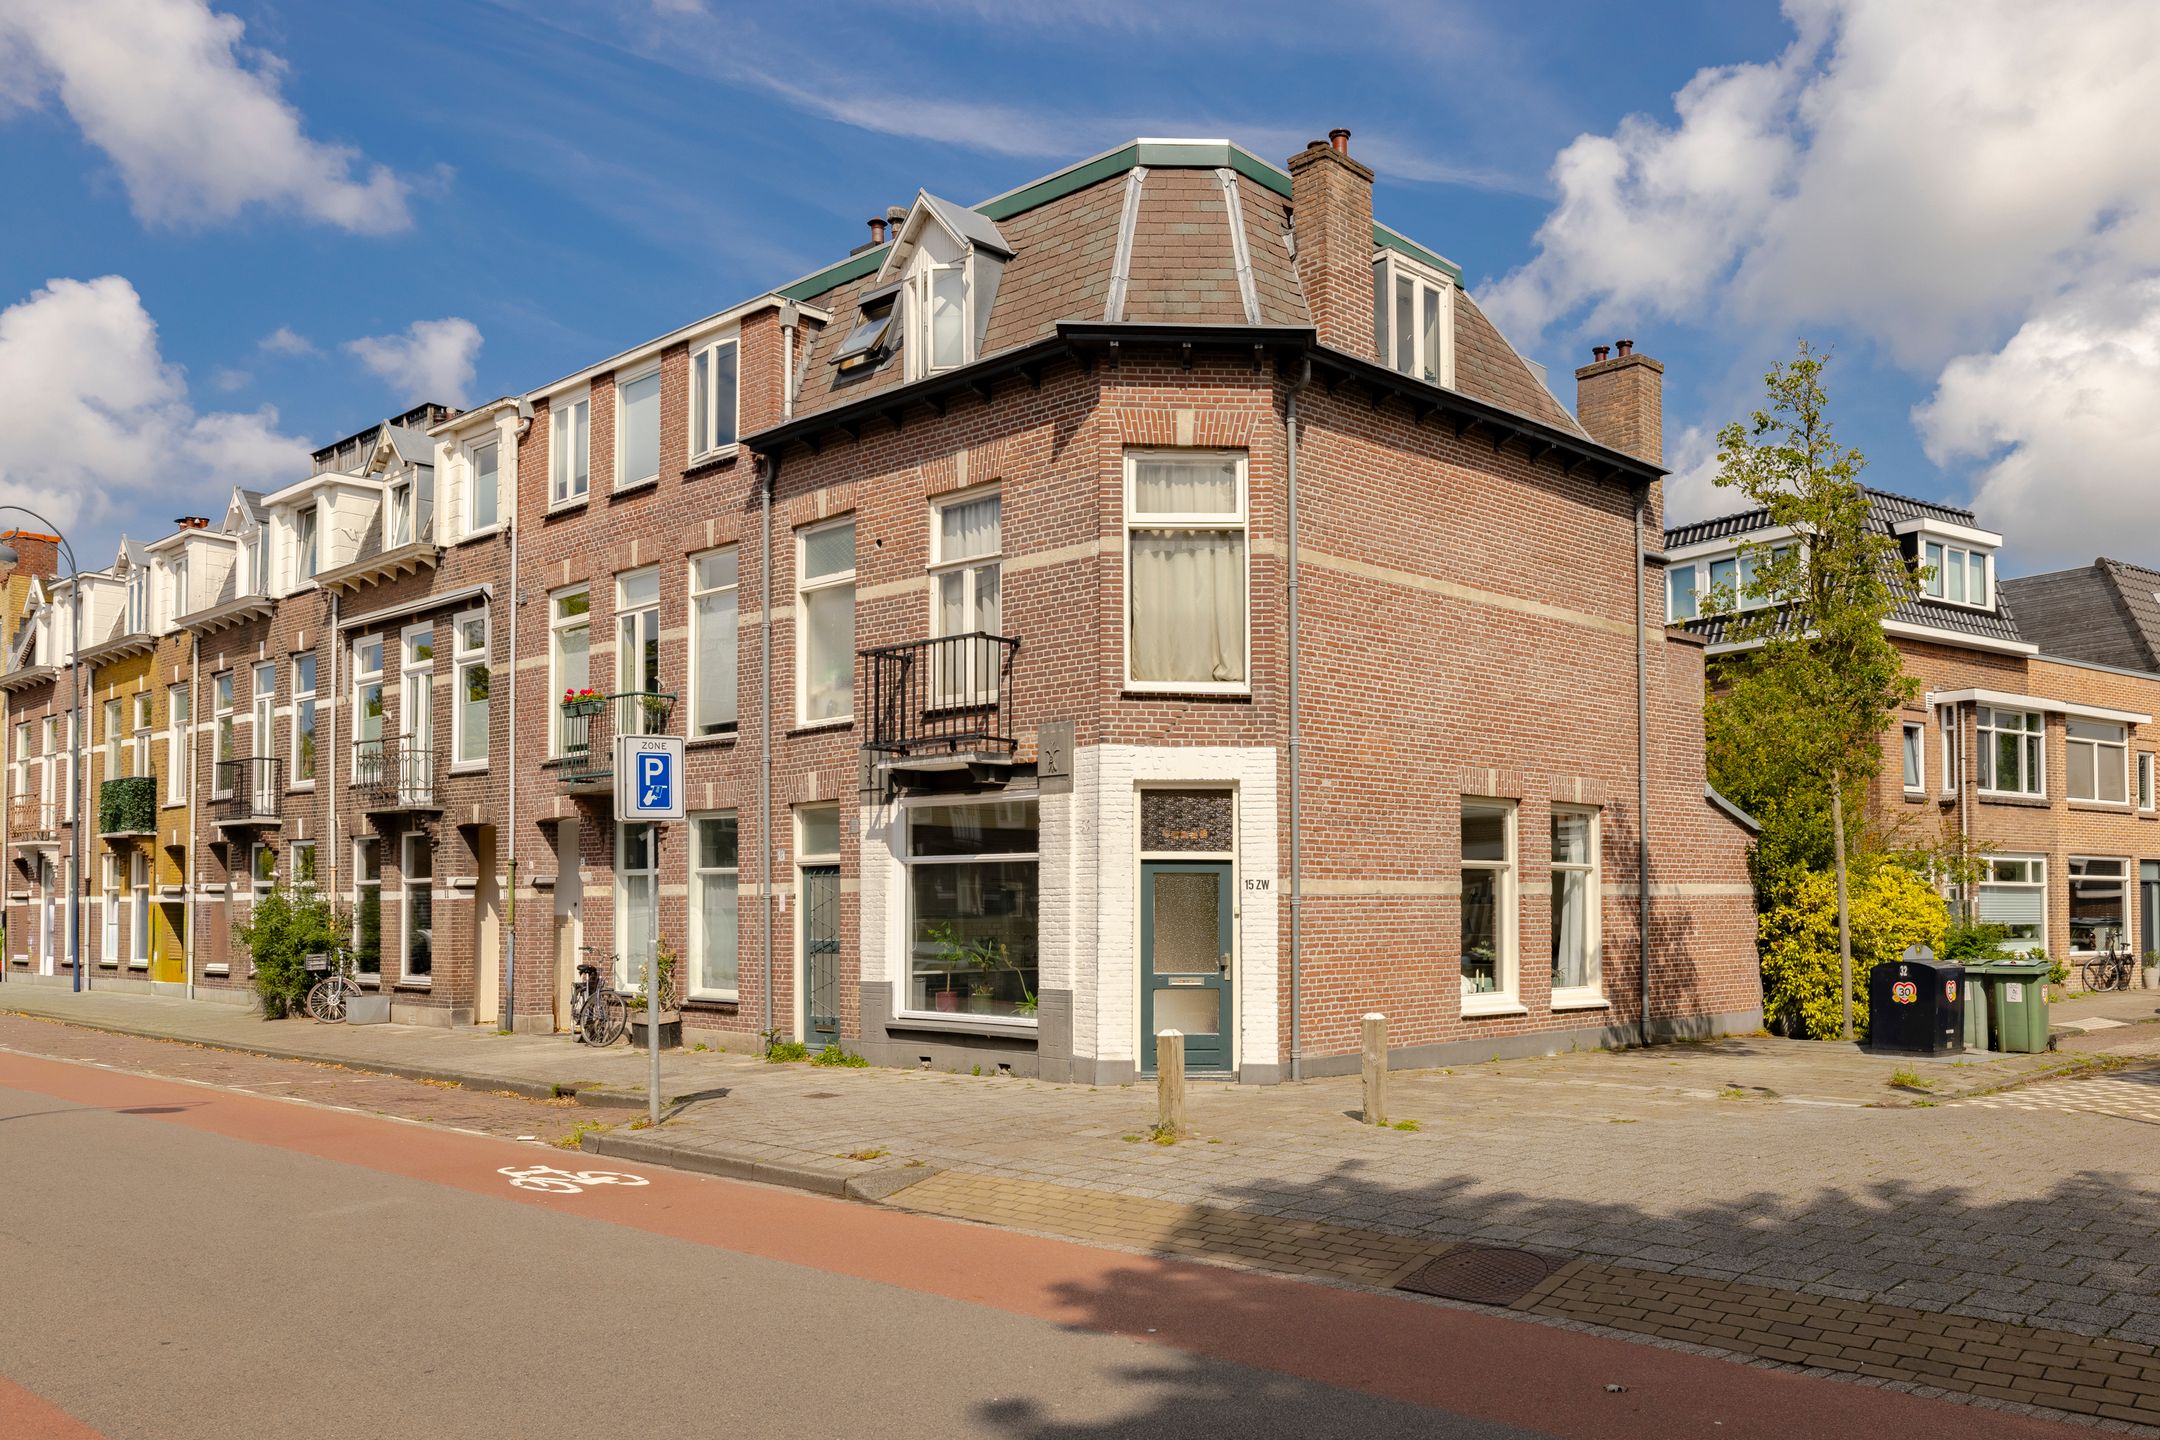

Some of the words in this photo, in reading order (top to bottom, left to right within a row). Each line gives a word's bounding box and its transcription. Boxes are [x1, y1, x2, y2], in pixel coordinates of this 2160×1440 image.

[641, 741, 667, 750] ZONE
[645, 758, 664, 786] P
[1245, 879, 1254, 890] 15
[1256, 879, 1270, 890] ZW
[1900, 965, 1908, 977] 32
[1898, 988, 1911, 997] 30
